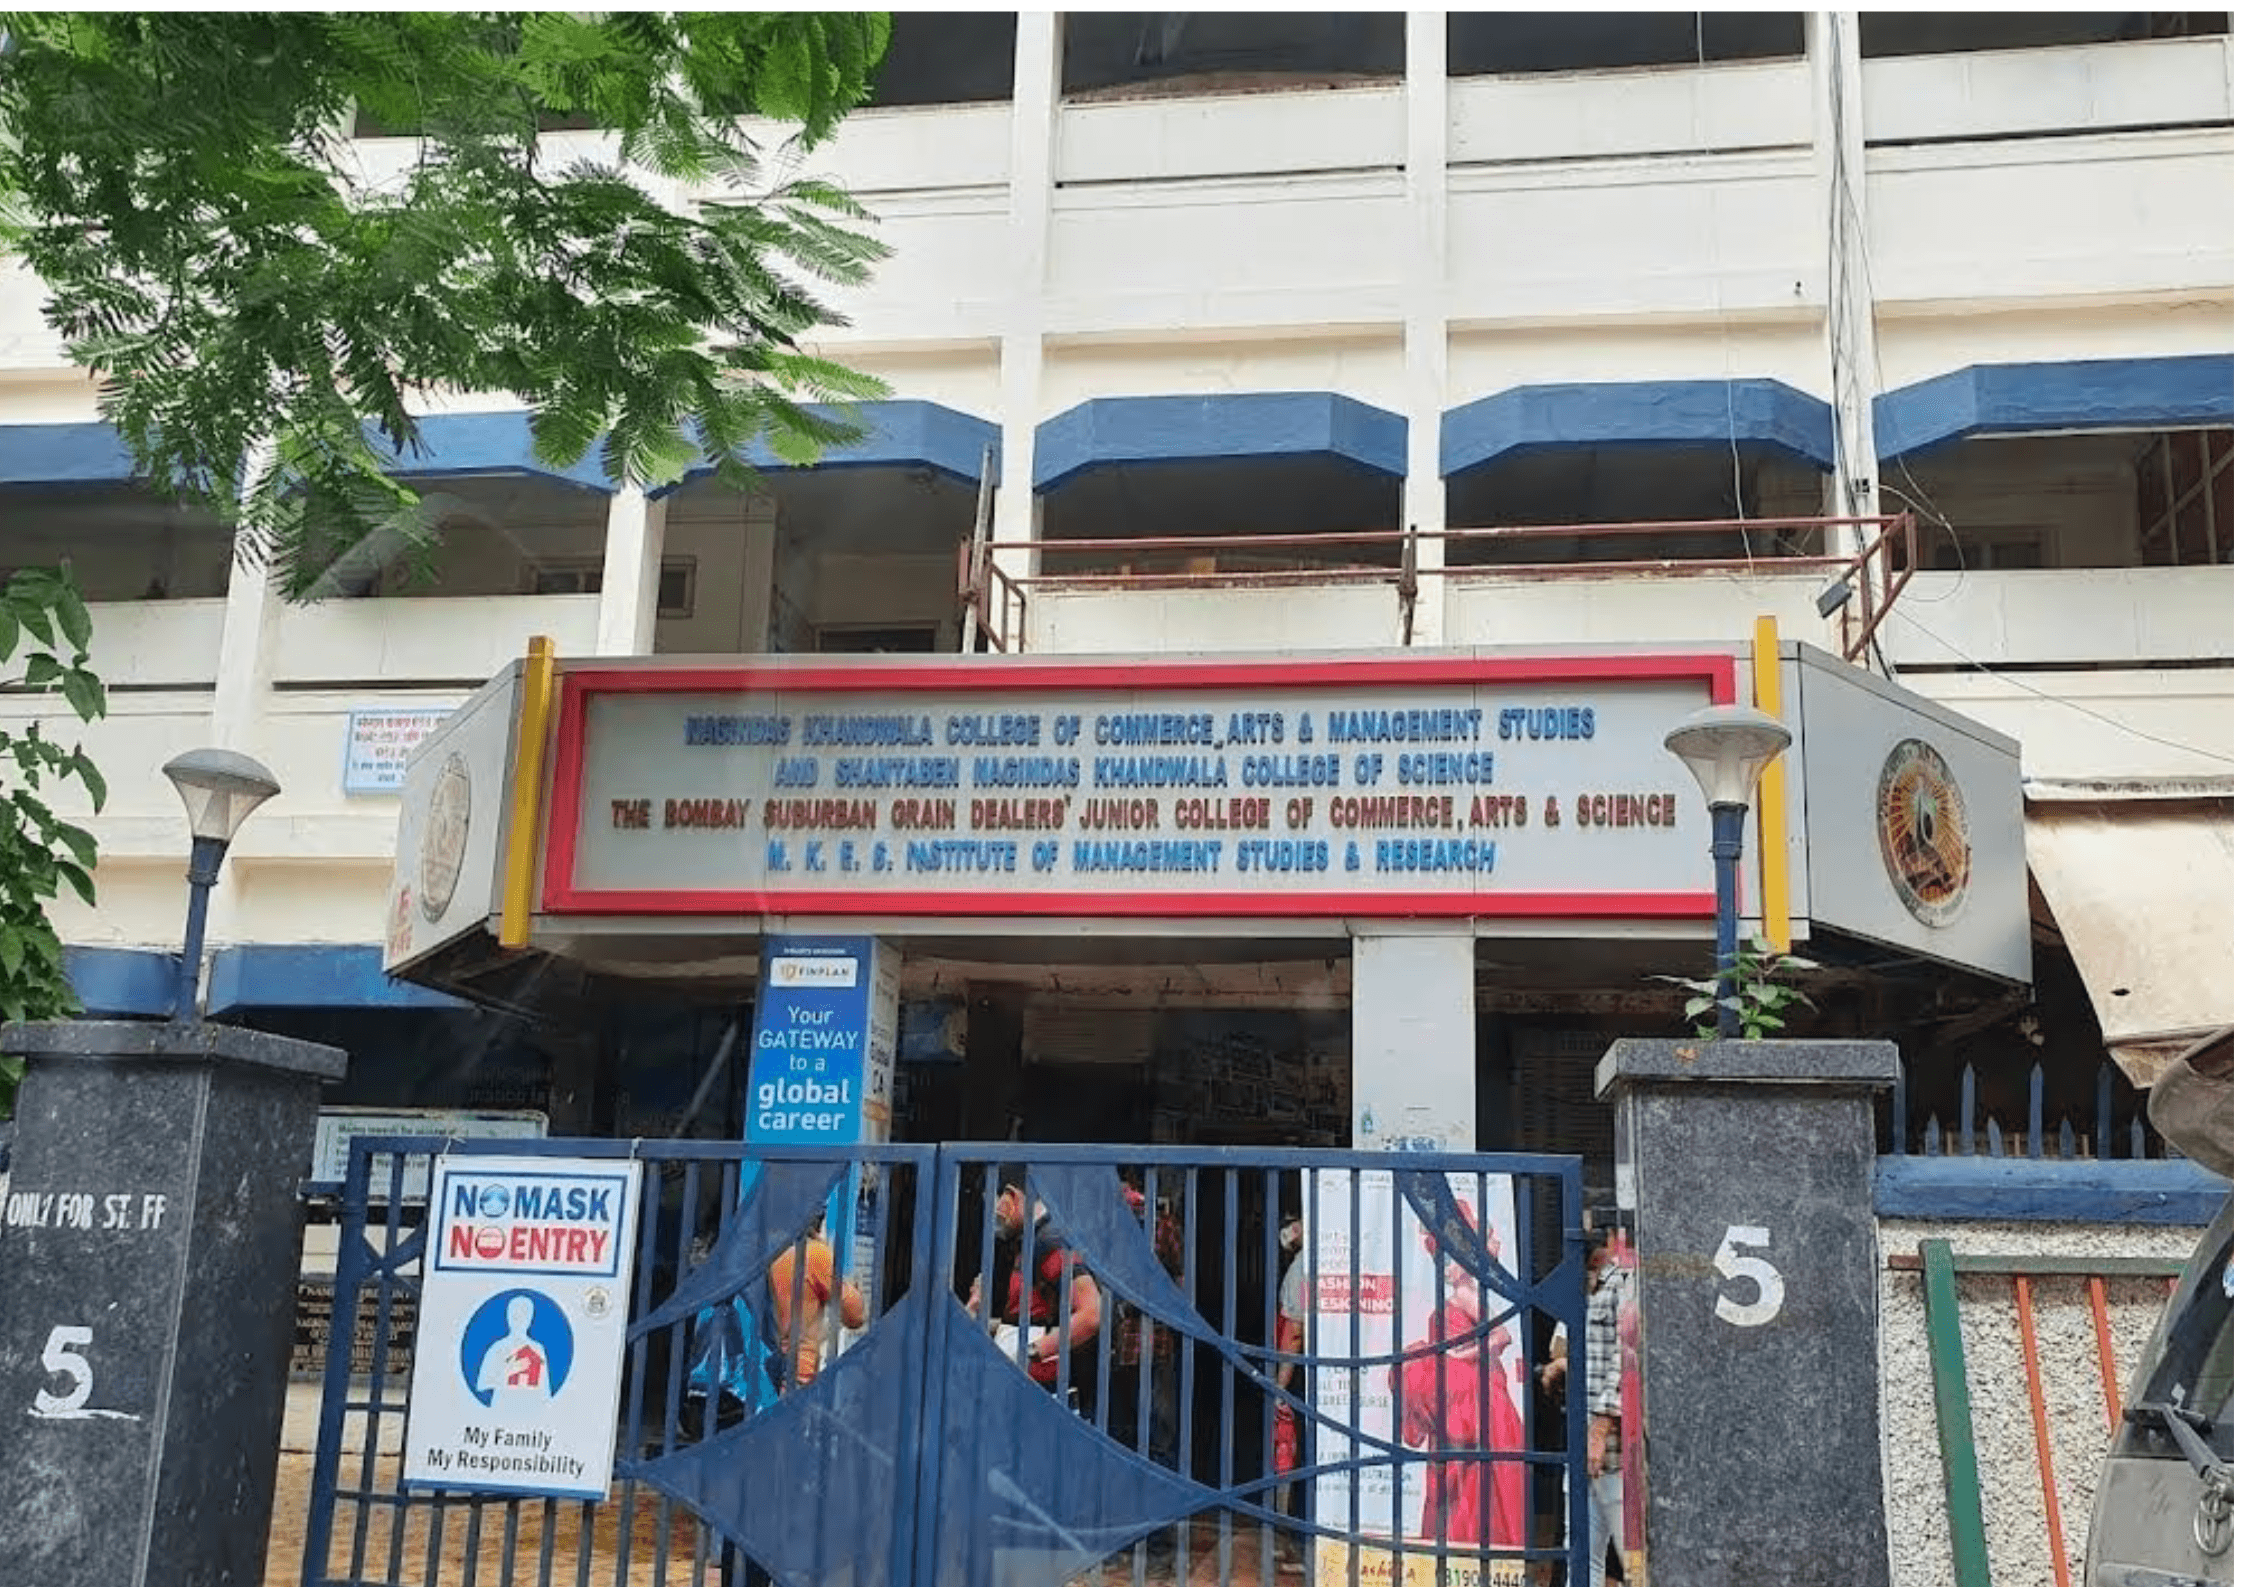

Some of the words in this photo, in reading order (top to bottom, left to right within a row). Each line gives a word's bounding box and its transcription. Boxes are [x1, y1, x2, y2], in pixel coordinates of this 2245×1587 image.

[947, 714, 1040, 746] COLLEGE
[1054, 715, 1080, 746] OF
[1299, 710, 1313, 743] &
[1328, 709, 1482, 742] MANAGEMENT
[1498, 707, 1595, 741] STUDIES
[774, 757, 819, 788] AND
[835, 757, 959, 788] SHANTABEN
[974, 757, 1080, 788] NAGINDAS
[1095, 755, 1228, 788] KHANDWALA
[1242, 754, 1340, 787] COLLEGE
[1354, 753, 1382, 786] OF
[1398, 751, 1494, 786] SCIENCE
[612, 798, 650, 829] THE
[665, 798, 750, 829] BOMBAY
[764, 798, 877, 830] SUBURBAN
[892, 798, 955, 830] GRAIN
[1079, 798, 1160, 830] JUNIOR
[1175, 798, 1270, 830] COLLEGE
[1287, 798, 1313, 829] OF
[1544, 796, 1560, 828] &
[1576, 794, 1676, 828] SCIENCE
[806, 841, 827, 871] K.
[840, 841, 860, 871] E.
[1032, 840, 1058, 872] OF
[1073, 840, 1222, 873] MANAGEMENT
[1236, 840, 1329, 872] STUDIES
[1345, 840, 1360, 871] &
[1376, 839, 1496, 873] RESEARCH
[788, 1005, 834, 1025] Your
[758, 1029, 858, 1049] GATEWAY
[789, 1054, 807, 1071] to
[815, 1057, 826, 1071] a
[758, 1077, 850, 1109] global
[758, 1111, 846, 1131] career
[56, 1193, 94, 1230] FOR
[141, 1194, 167, 1229] FF
[1714, 1226, 1786, 1327] 5
[33, 1325, 94, 1412] 5
[463, 1426, 489, 1448] My
[494, 1428, 552, 1452] Family
[427, 1448, 452, 1470] My
[457, 1450, 585, 1479] Responsibility
